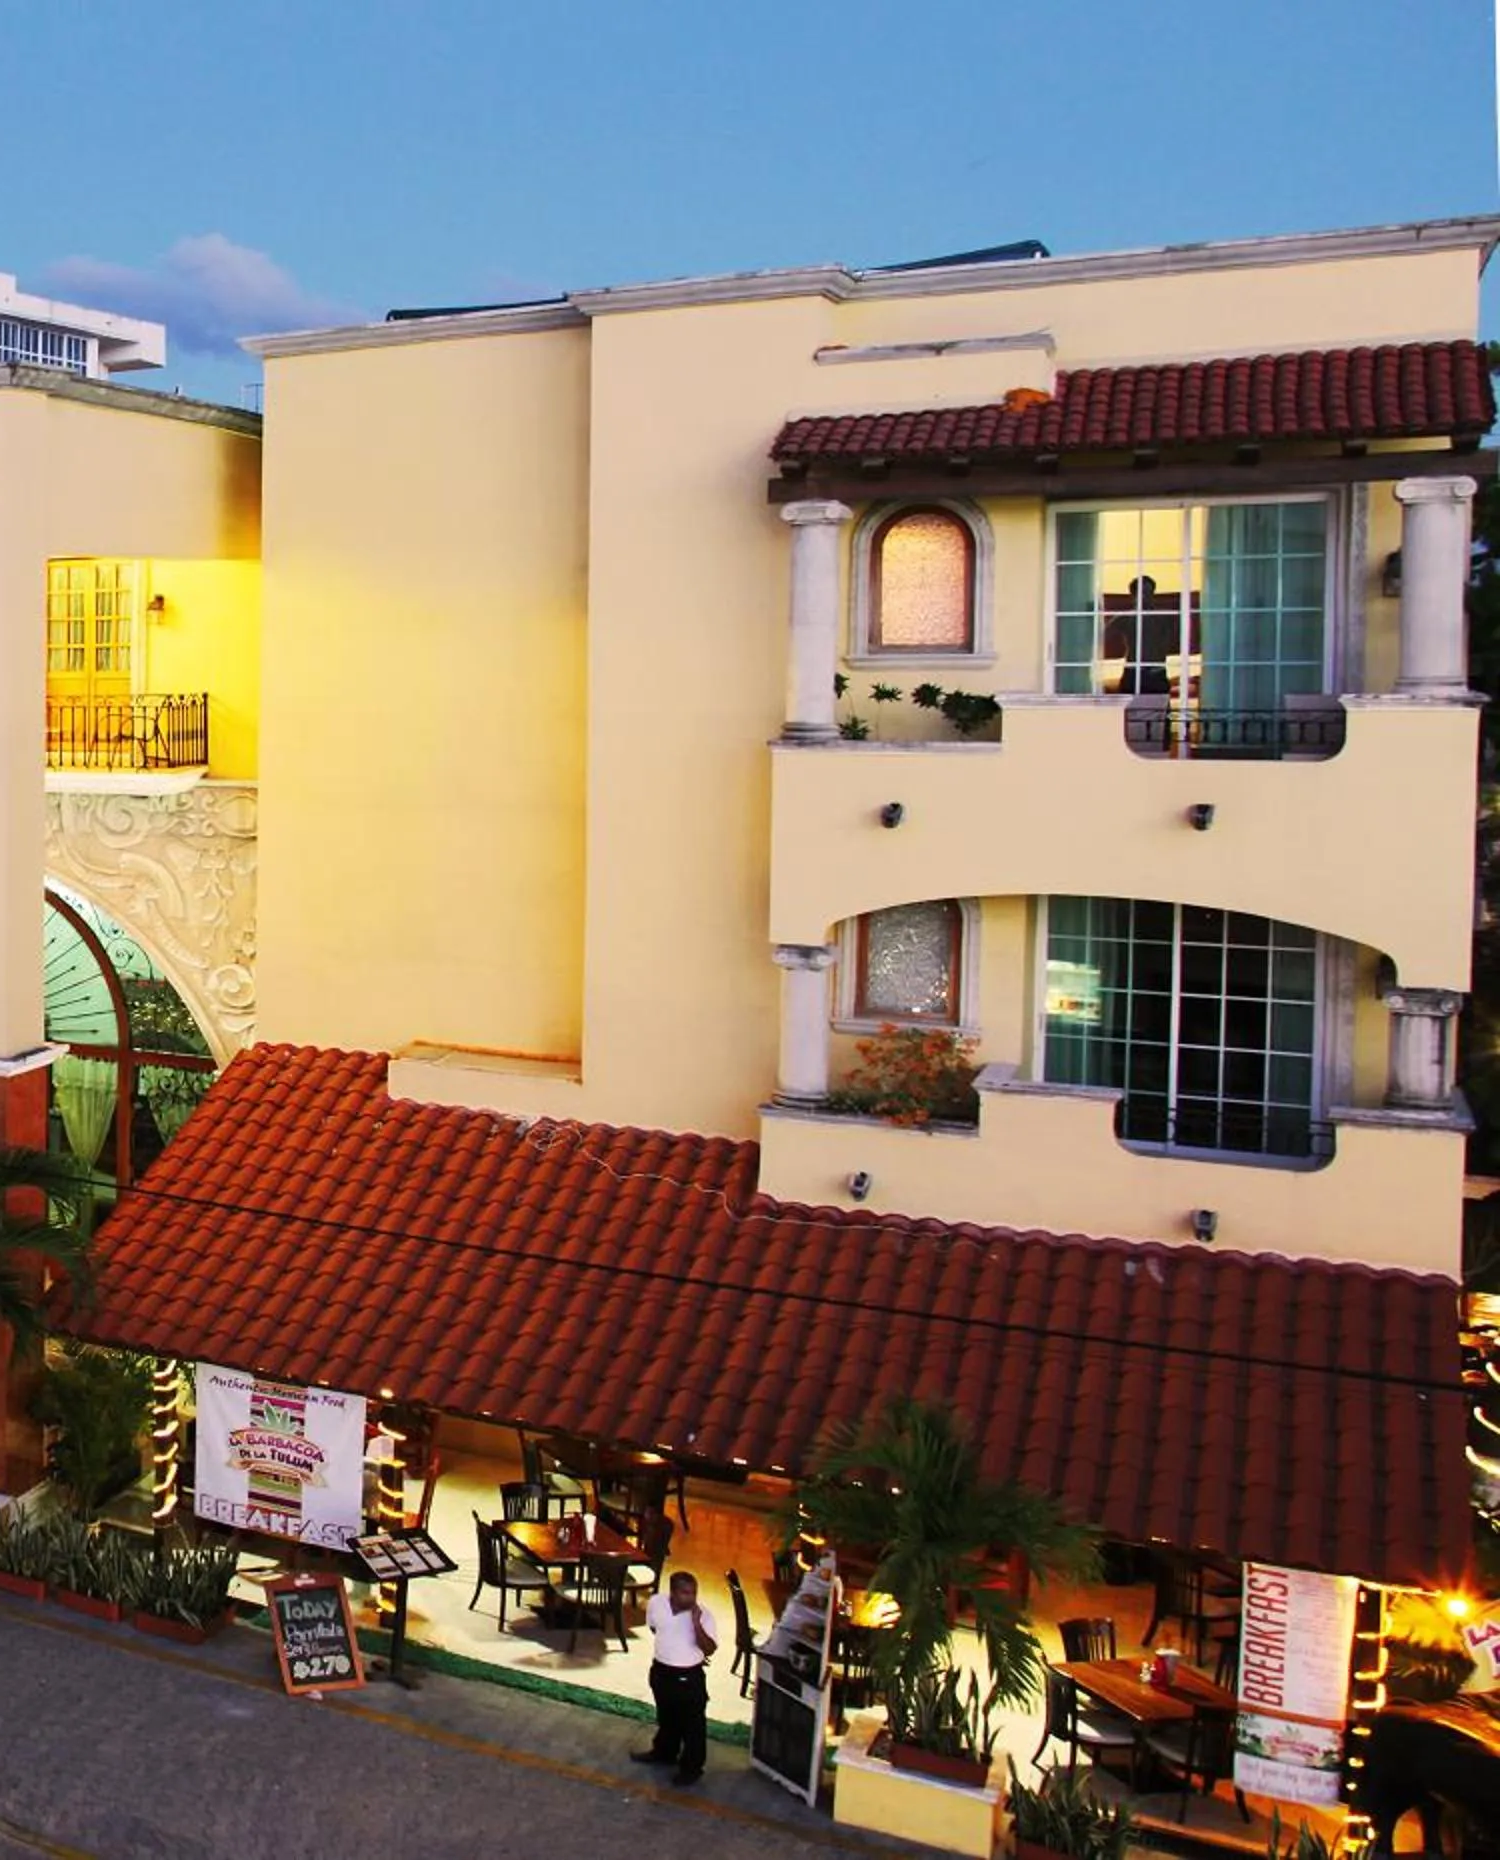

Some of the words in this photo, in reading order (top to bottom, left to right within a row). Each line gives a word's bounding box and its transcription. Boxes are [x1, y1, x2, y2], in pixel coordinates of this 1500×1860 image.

[245, 1432, 325, 1463] BARBACOA
[269, 1448, 313, 1473] TULUM
[199, 1493, 357, 1551] BREAKFAST
[1243, 1562, 1289, 1708] BREAKFAST
